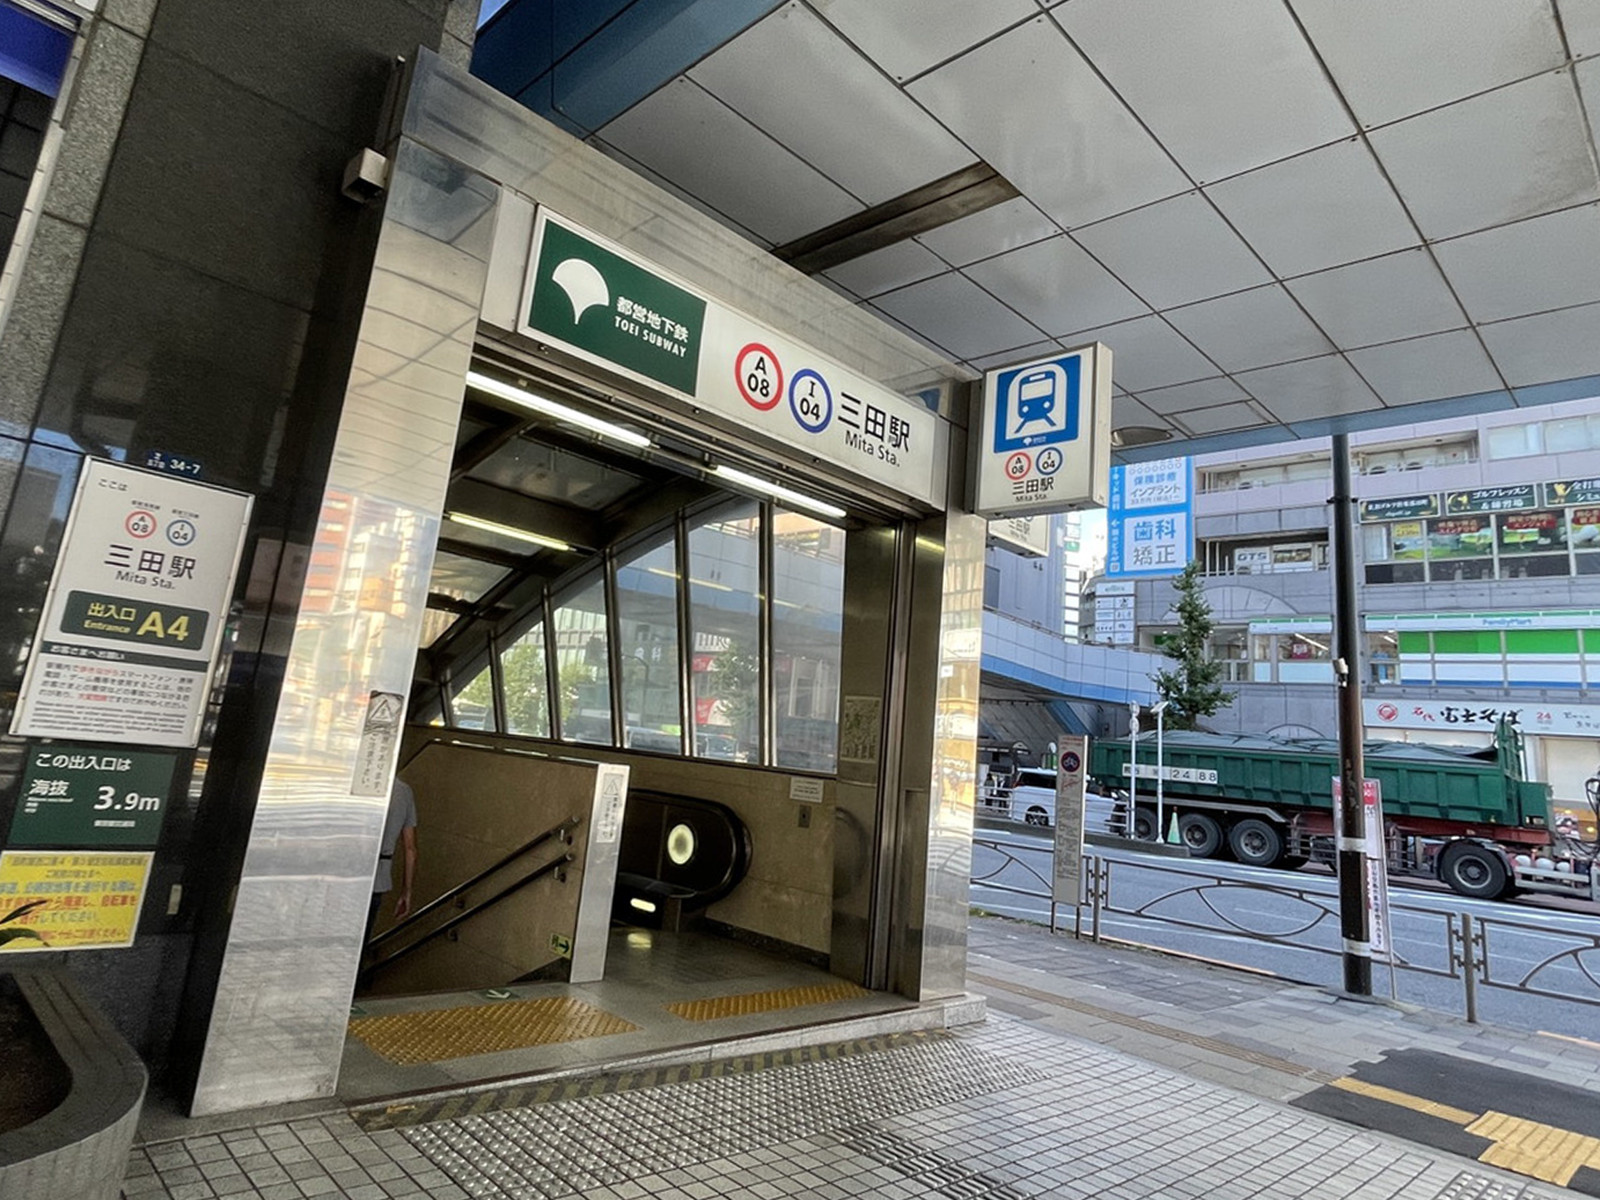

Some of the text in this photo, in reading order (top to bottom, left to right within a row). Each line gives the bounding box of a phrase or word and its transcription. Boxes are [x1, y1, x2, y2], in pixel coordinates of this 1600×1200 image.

[616, 296, 689, 343] 都営地下鉄
[614, 315, 687, 358] TOEI SUBWAY
[754, 356, 767, 375] A
[747, 373, 770, 398] 08
[808, 380, 816, 398] I
[799, 397, 821, 421] 04
[838, 391, 910, 453] 三田駅
[844, 430, 901, 468] Mita Sta.
[169, 459, 201, 474] 34-7
[1011, 465, 1025, 475] 08
[1015, 456, 1022, 465] A
[1041, 460, 1056, 470] 04
[98, 478, 128, 491] ここは
[1012, 477, 1054, 496] 三田駅
[1131, 484, 1181, 498] インプラント
[1472, 486, 1530, 500] ゴルフレッスン
[131, 522, 149, 534] 08
[172, 530, 188, 541] 04
[1134, 518, 1176, 542] 歯科
[104, 543, 196, 580] 三田駅
[1133, 544, 1177, 566] 矯正
[115, 570, 176, 590] Mita Sta.
[87, 602, 136, 622] 出入口
[83, 619, 131, 635] Entrance
[136, 610, 190, 642] A4
[1440, 706, 1524, 725] 富士そば
[35, 753, 132, 772] この出入口は
[28, 779, 70, 797] 海抜
[93, 785, 161, 812] 3.9m
